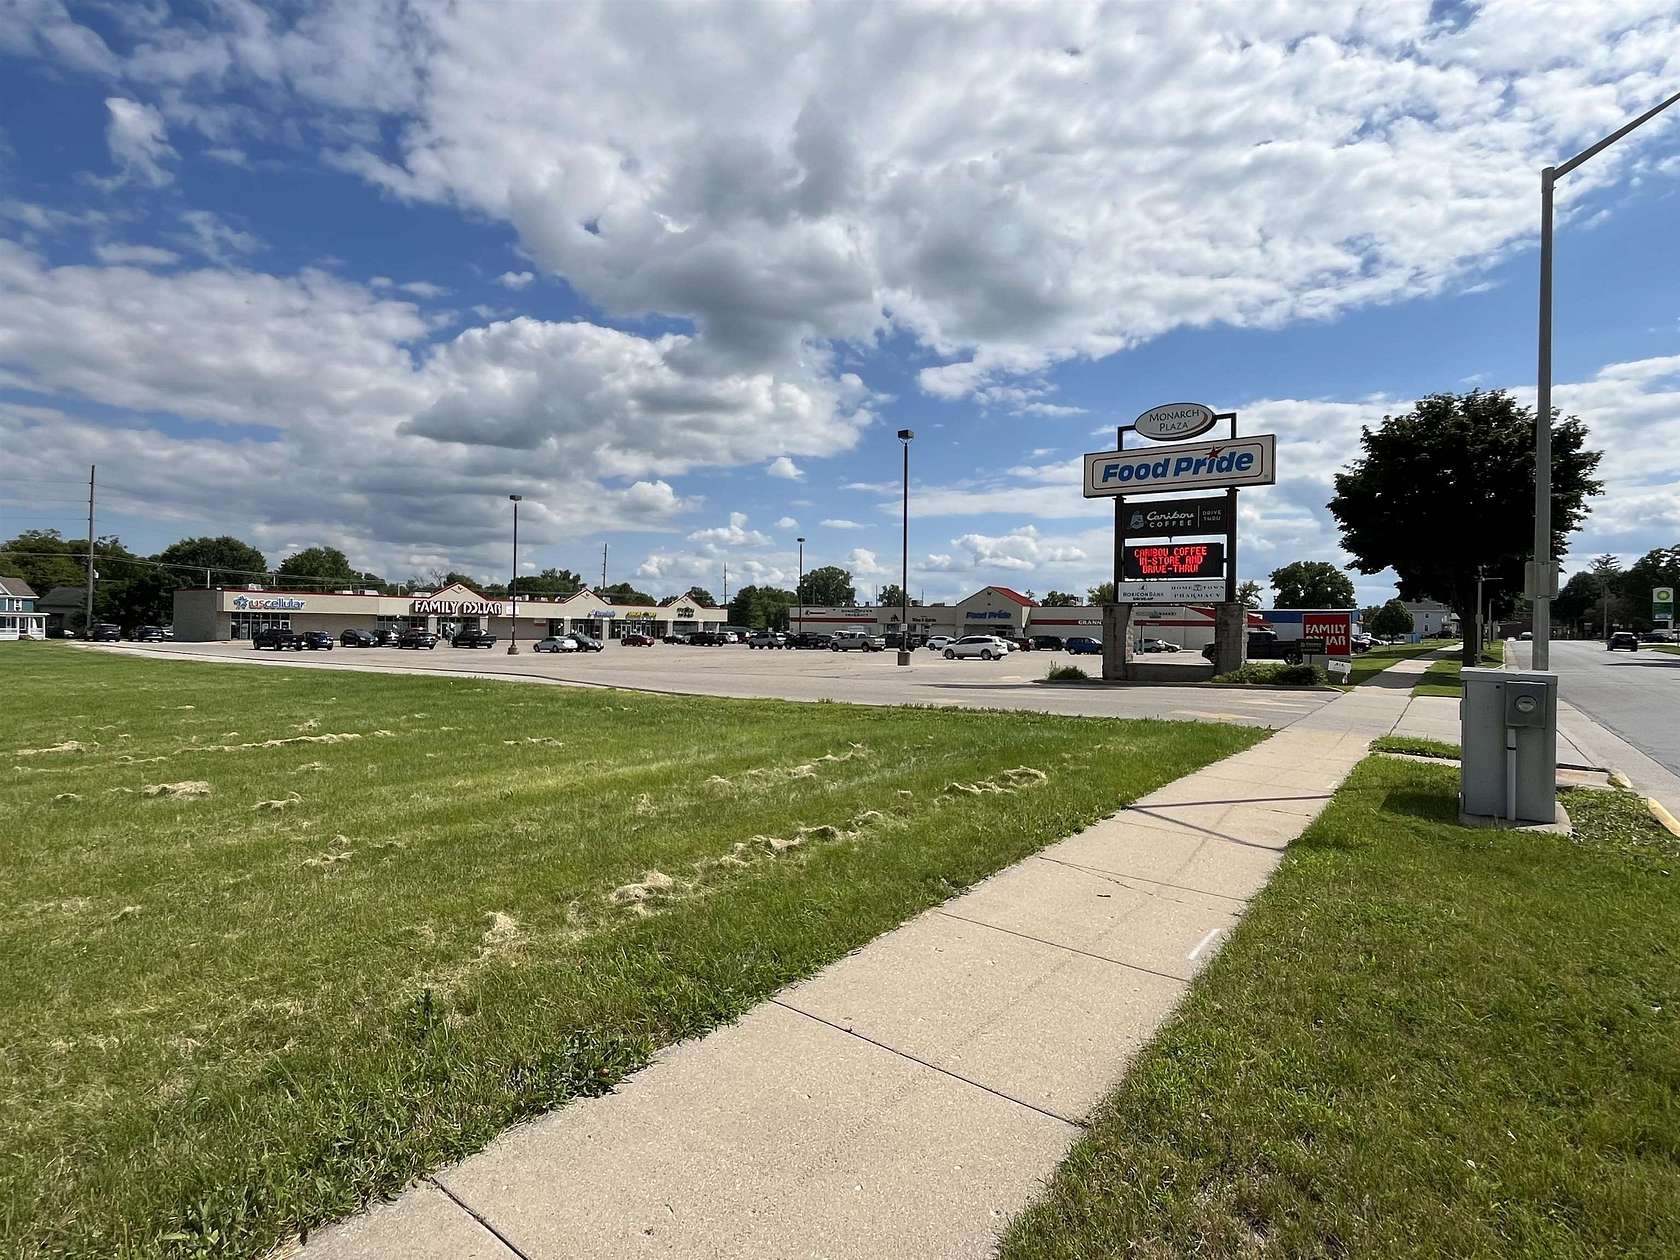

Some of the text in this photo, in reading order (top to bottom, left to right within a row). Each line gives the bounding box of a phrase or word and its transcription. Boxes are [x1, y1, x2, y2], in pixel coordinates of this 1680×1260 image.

[1149, 409, 1200, 422] MONARCH
[1159, 423, 1188, 431] PLAZA
[1102, 450, 1254, 482] Food Pride
[1146, 511, 1195, 521] Caribou
[1149, 520, 1192, 528] COFFEE
[1134, 546, 1207, 558] CARIBOU COFFEE
[1139, 555, 1203, 566] IN-STORE AND
[1142, 564, 1199, 574] DRIVE-THRU!
[414, 600, 459, 614] FAMILY
[1305, 624, 1346, 633] FAMILY
